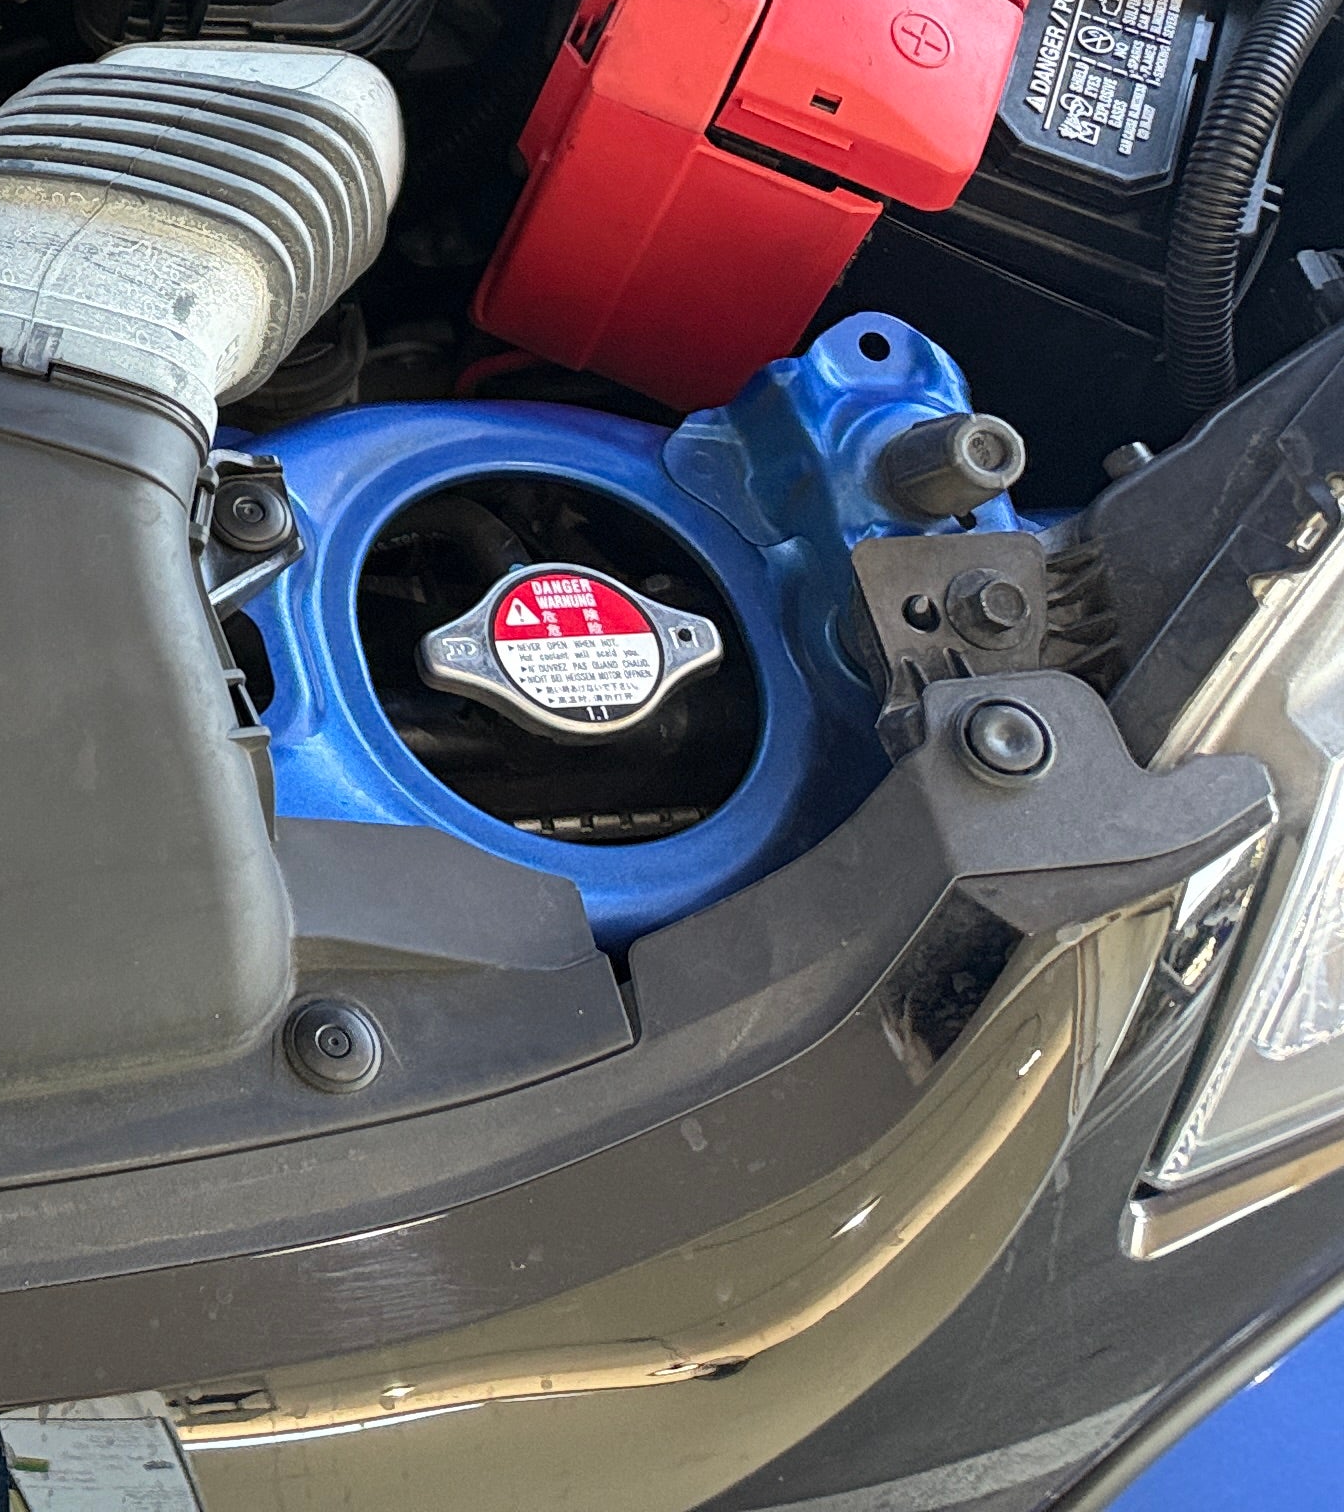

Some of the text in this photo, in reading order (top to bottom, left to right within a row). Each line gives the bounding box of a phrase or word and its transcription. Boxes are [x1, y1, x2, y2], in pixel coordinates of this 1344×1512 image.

[1113, 42, 1129, 58] NO
[531, 578, 593, 596] DANGER
[547, 641, 568, 650] OPEN
[586, 705, 610, 721] 1.1
